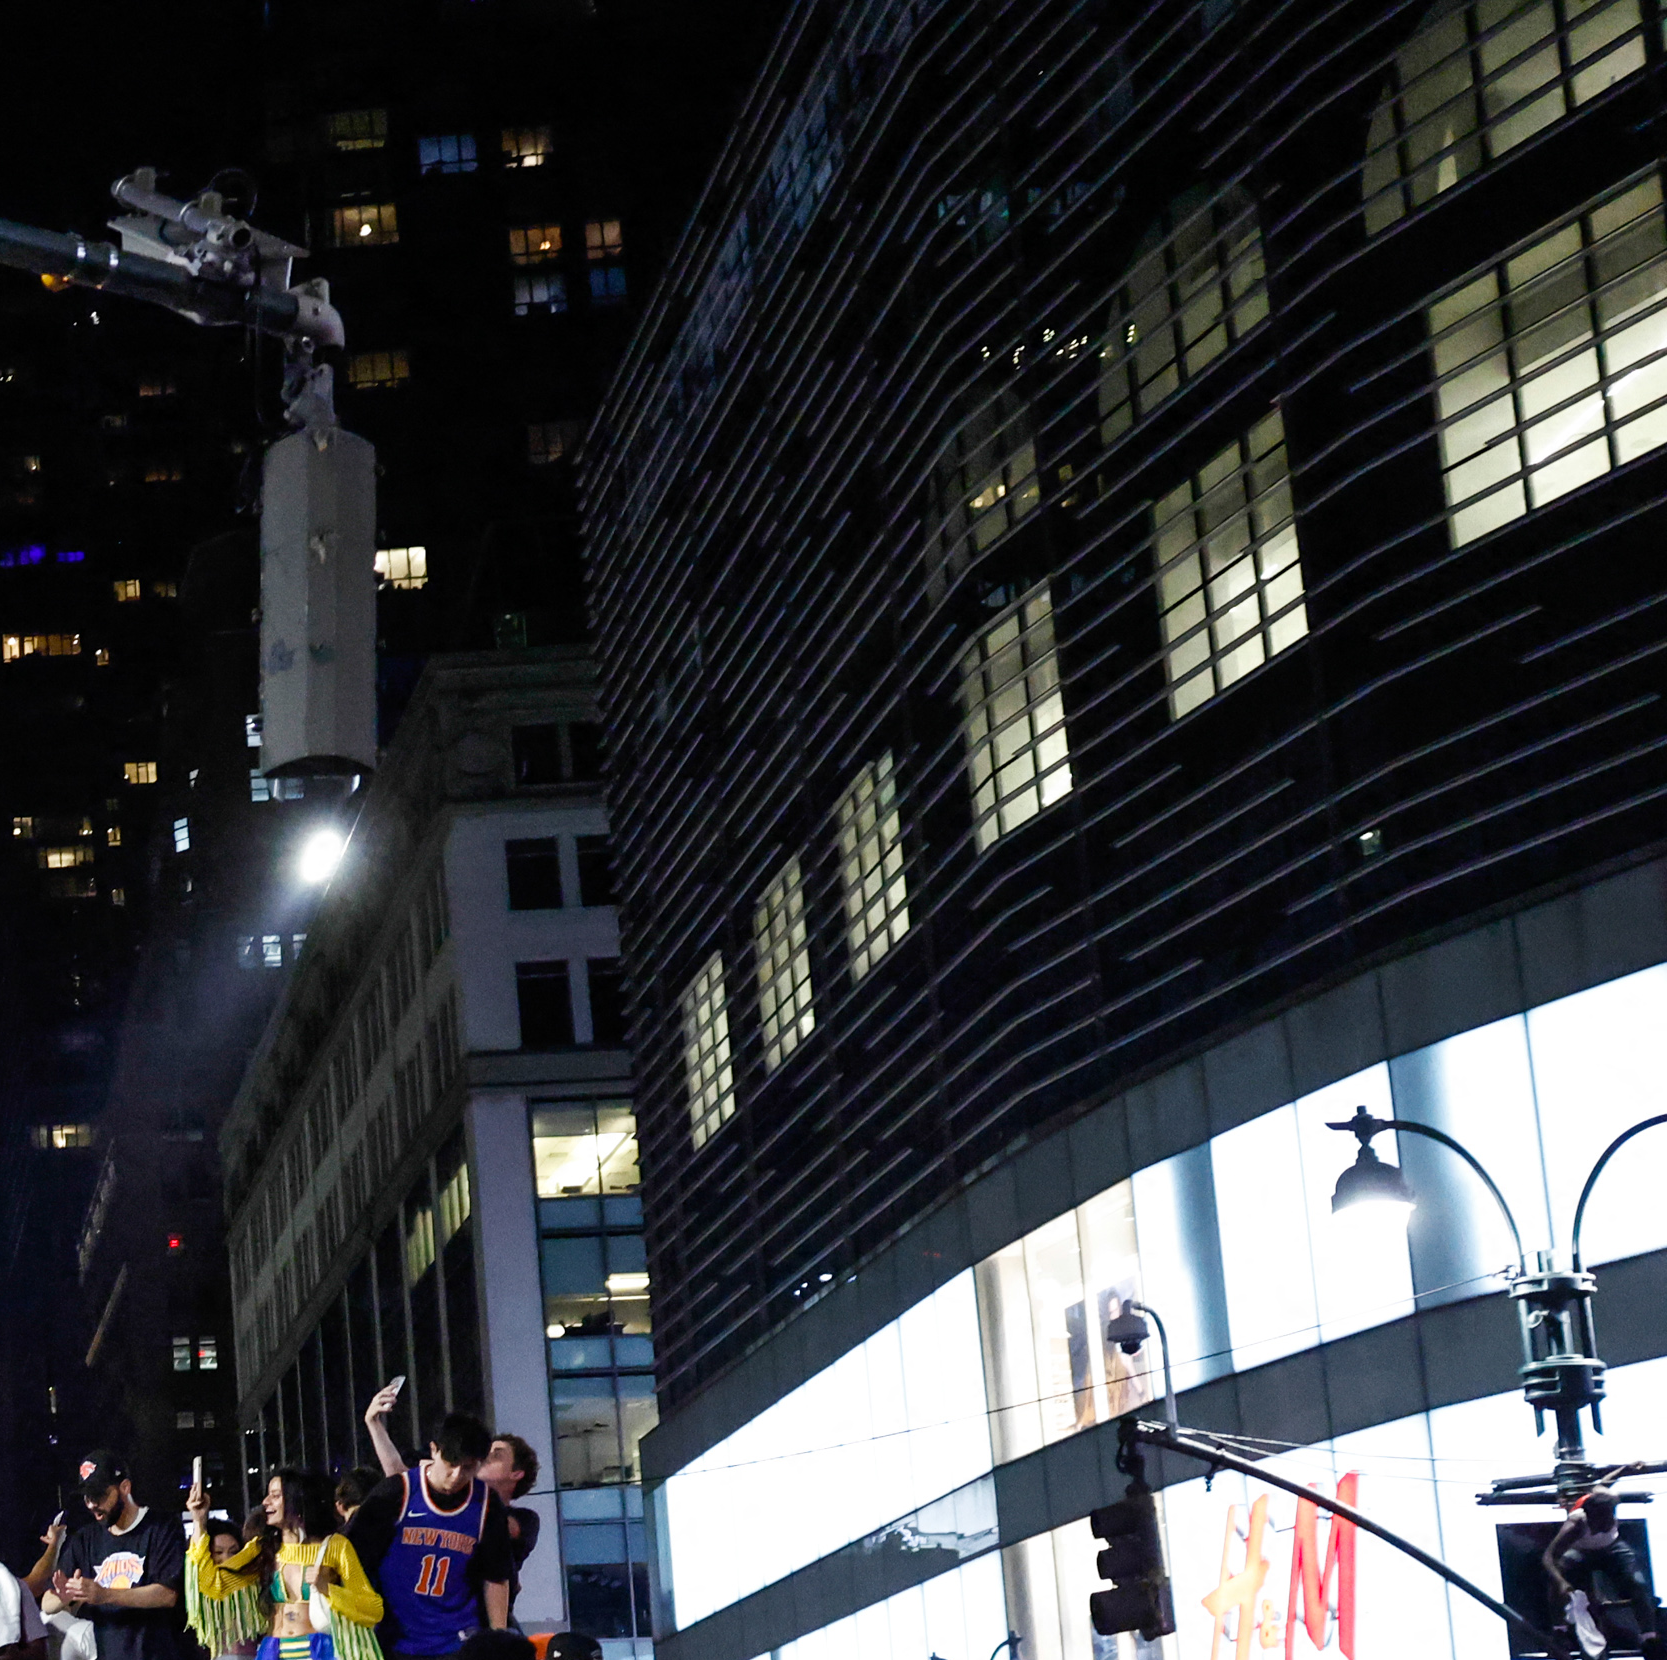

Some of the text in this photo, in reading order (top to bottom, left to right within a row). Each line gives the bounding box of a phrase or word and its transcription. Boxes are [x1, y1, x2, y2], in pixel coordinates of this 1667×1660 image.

[401, 1526, 478, 1556] NEW YORK
[414, 1553, 451, 1598] 11
